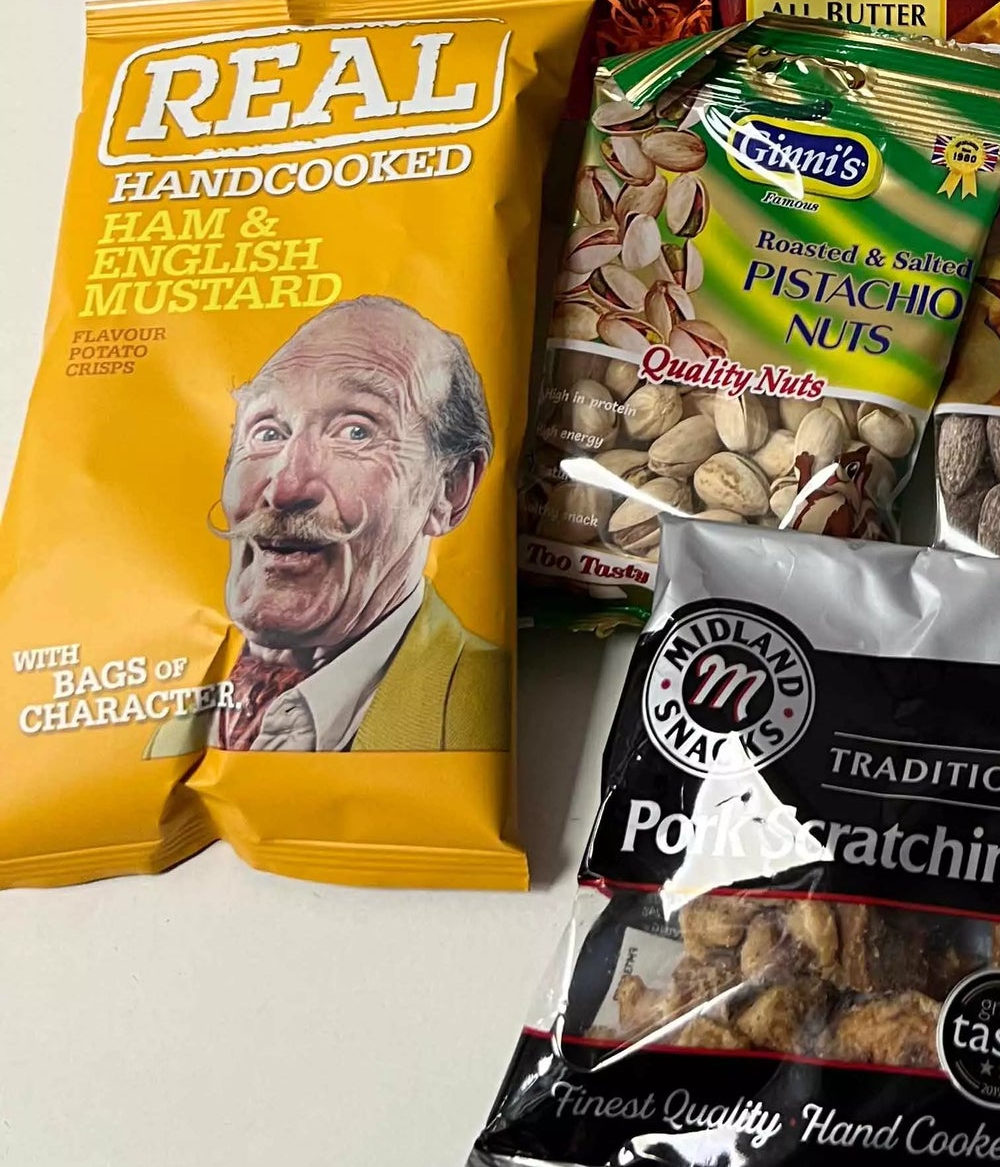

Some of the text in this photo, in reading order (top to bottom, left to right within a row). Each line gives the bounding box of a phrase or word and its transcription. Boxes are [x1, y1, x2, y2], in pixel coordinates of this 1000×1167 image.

[827, 1, 927, 27] BUTTER
[127, 33, 479, 141] REAL
[108, 143, 473, 204] HANDCOOKED
[740, 130, 861, 180] Ginni's
[953, 152, 977, 163] 1980
[763, 192, 819, 212] Famous
[98, 206, 279, 245] HAM &
[88, 238, 323, 281] ENGLISH
[756, 229, 973, 279] Roasted & Salted
[79, 273, 343, 318] MUSTARD
[743, 262, 964, 320] PISTACHIO
[69, 344, 148, 360] POTATO
[72, 327, 167, 343] FLAVOUR
[785, 313, 894, 355] NUTS
[66, 361, 135, 377] CRISPS
[641, 346, 826, 399] Quality Nuts
[589, 398, 637, 417] protein
[561, 430, 604, 449] energy
[580, 555, 650, 585] Tasty
[13, 643, 80, 672] WITH
[53, 657, 188, 700] BAGS OF
[664, 617, 804, 697] MIDLAND
[19, 681, 243, 733] CHARACTER.
[621, 798, 744, 858] Pork
[551, 1081, 782, 1149] Finest Quality
[800, 1103, 903, 1150] Hand
